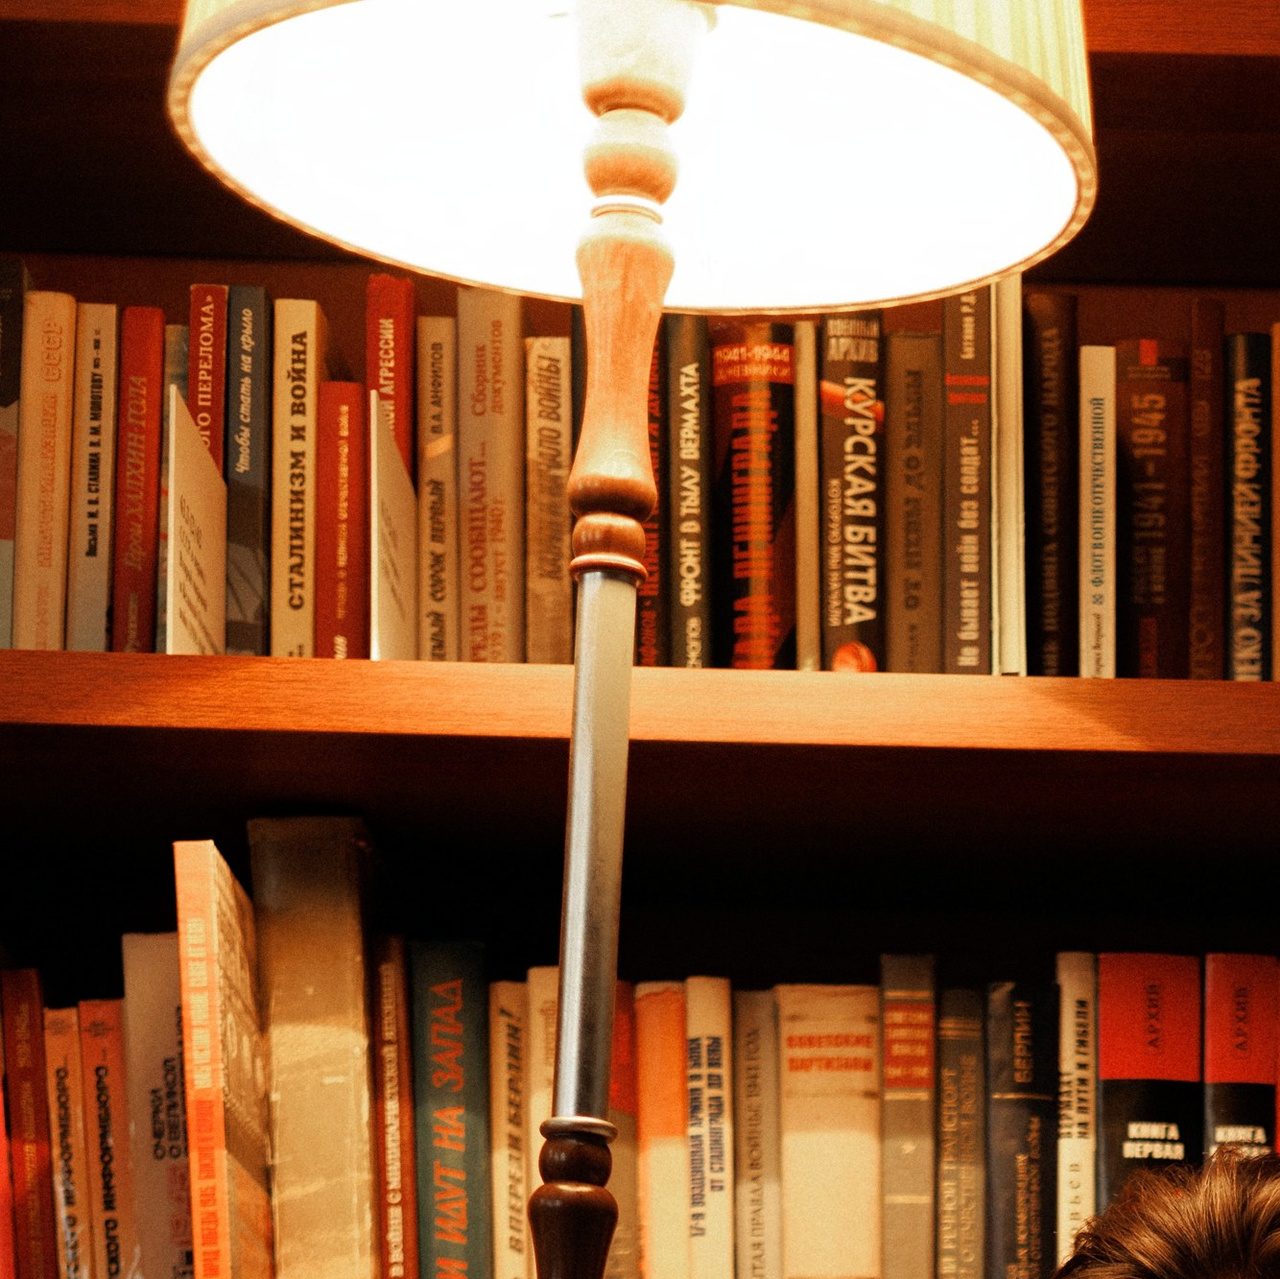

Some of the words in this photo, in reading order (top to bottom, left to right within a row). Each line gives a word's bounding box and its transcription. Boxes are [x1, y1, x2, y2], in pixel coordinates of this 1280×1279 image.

[198, 294, 215, 407] ПЕРЕЛОМА»
[240, 307, 255, 349] крыло
[242, 352, 252, 372] на
[377, 318, 396, 396] АГРЕССИИ
[240, 376, 250, 423] стать
[287, 330, 308, 417] ВОЙНА
[432, 341, 444, 409] АНФИЛОВ
[470, 344, 490, 417] Сборник
[489, 319, 506, 416] документов
[536, 355, 563, 422] ВОЙНЫ
[1041, 326, 1061, 407] НАРОДА
[290, 424, 306, 443] И
[681, 361, 701, 459] ВЕРМАХТА
[1235, 377, 1262, 479] ФРОНТА
[235, 425, 251, 473] Чтобы
[843, 377, 878, 518] КУРСКАЯ
[680, 465, 701, 516] ТЫЛУ
[955, 499, 979, 530] без
[287, 450, 306, 611] СТАЛИНИЗМ
[681, 521, 700, 533] В
[956, 534, 979, 573] войн
[1232, 482, 1262, 585] ЛИНИЕЙ
[679, 538, 702, 607] ФРОНТ
[843, 524, 878, 626] БИТВА
[1235, 590, 1261, 621] ЗА
[955, 579, 980, 640] бывает
[958, 647, 979, 667] Не
[430, 978, 464, 1094] ЗАПАД
[1014, 1001, 1034, 1084] БЕРЛИН
[1075, 999, 1089, 1057] ГИБЕЛИ
[1146, 982, 1162, 1051] АРХИВ
[1234, 985, 1250, 1053] АРХИВ
[434, 1105, 466, 1153] НА
[941, 1069, 958, 1172] ТРАНСПОРТ
[1075, 1077, 1089, 1116] ПУТИ
[1075, 1122, 1089, 1140] НА
[386, 1205, 403, 1262] ВОЙНЕ
[434, 1160, 468, 1245] ИДУТ
